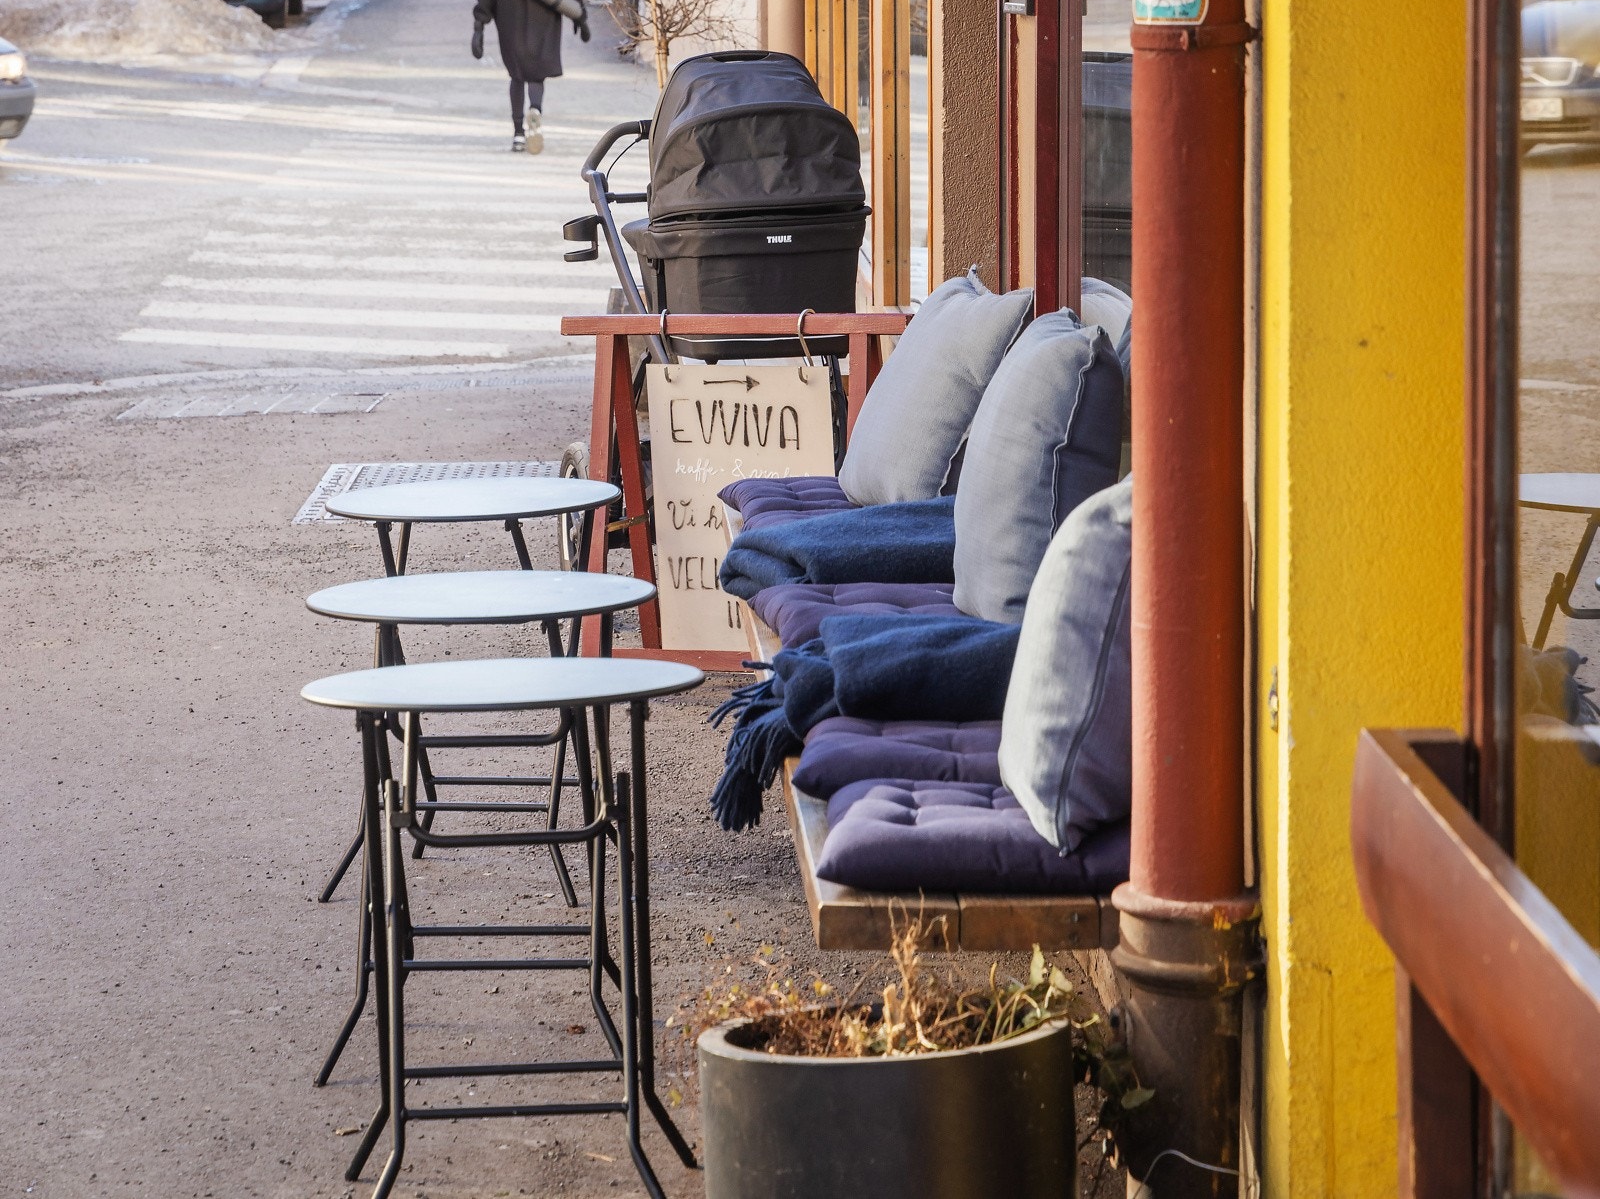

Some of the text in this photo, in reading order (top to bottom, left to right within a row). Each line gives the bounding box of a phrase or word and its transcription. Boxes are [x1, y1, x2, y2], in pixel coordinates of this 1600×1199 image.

[766, 234, 792, 244] THULE
[669, 398, 800, 451] EVVIVA
[731, 458, 746, 479] &
[667, 498, 697, 530] Vi
